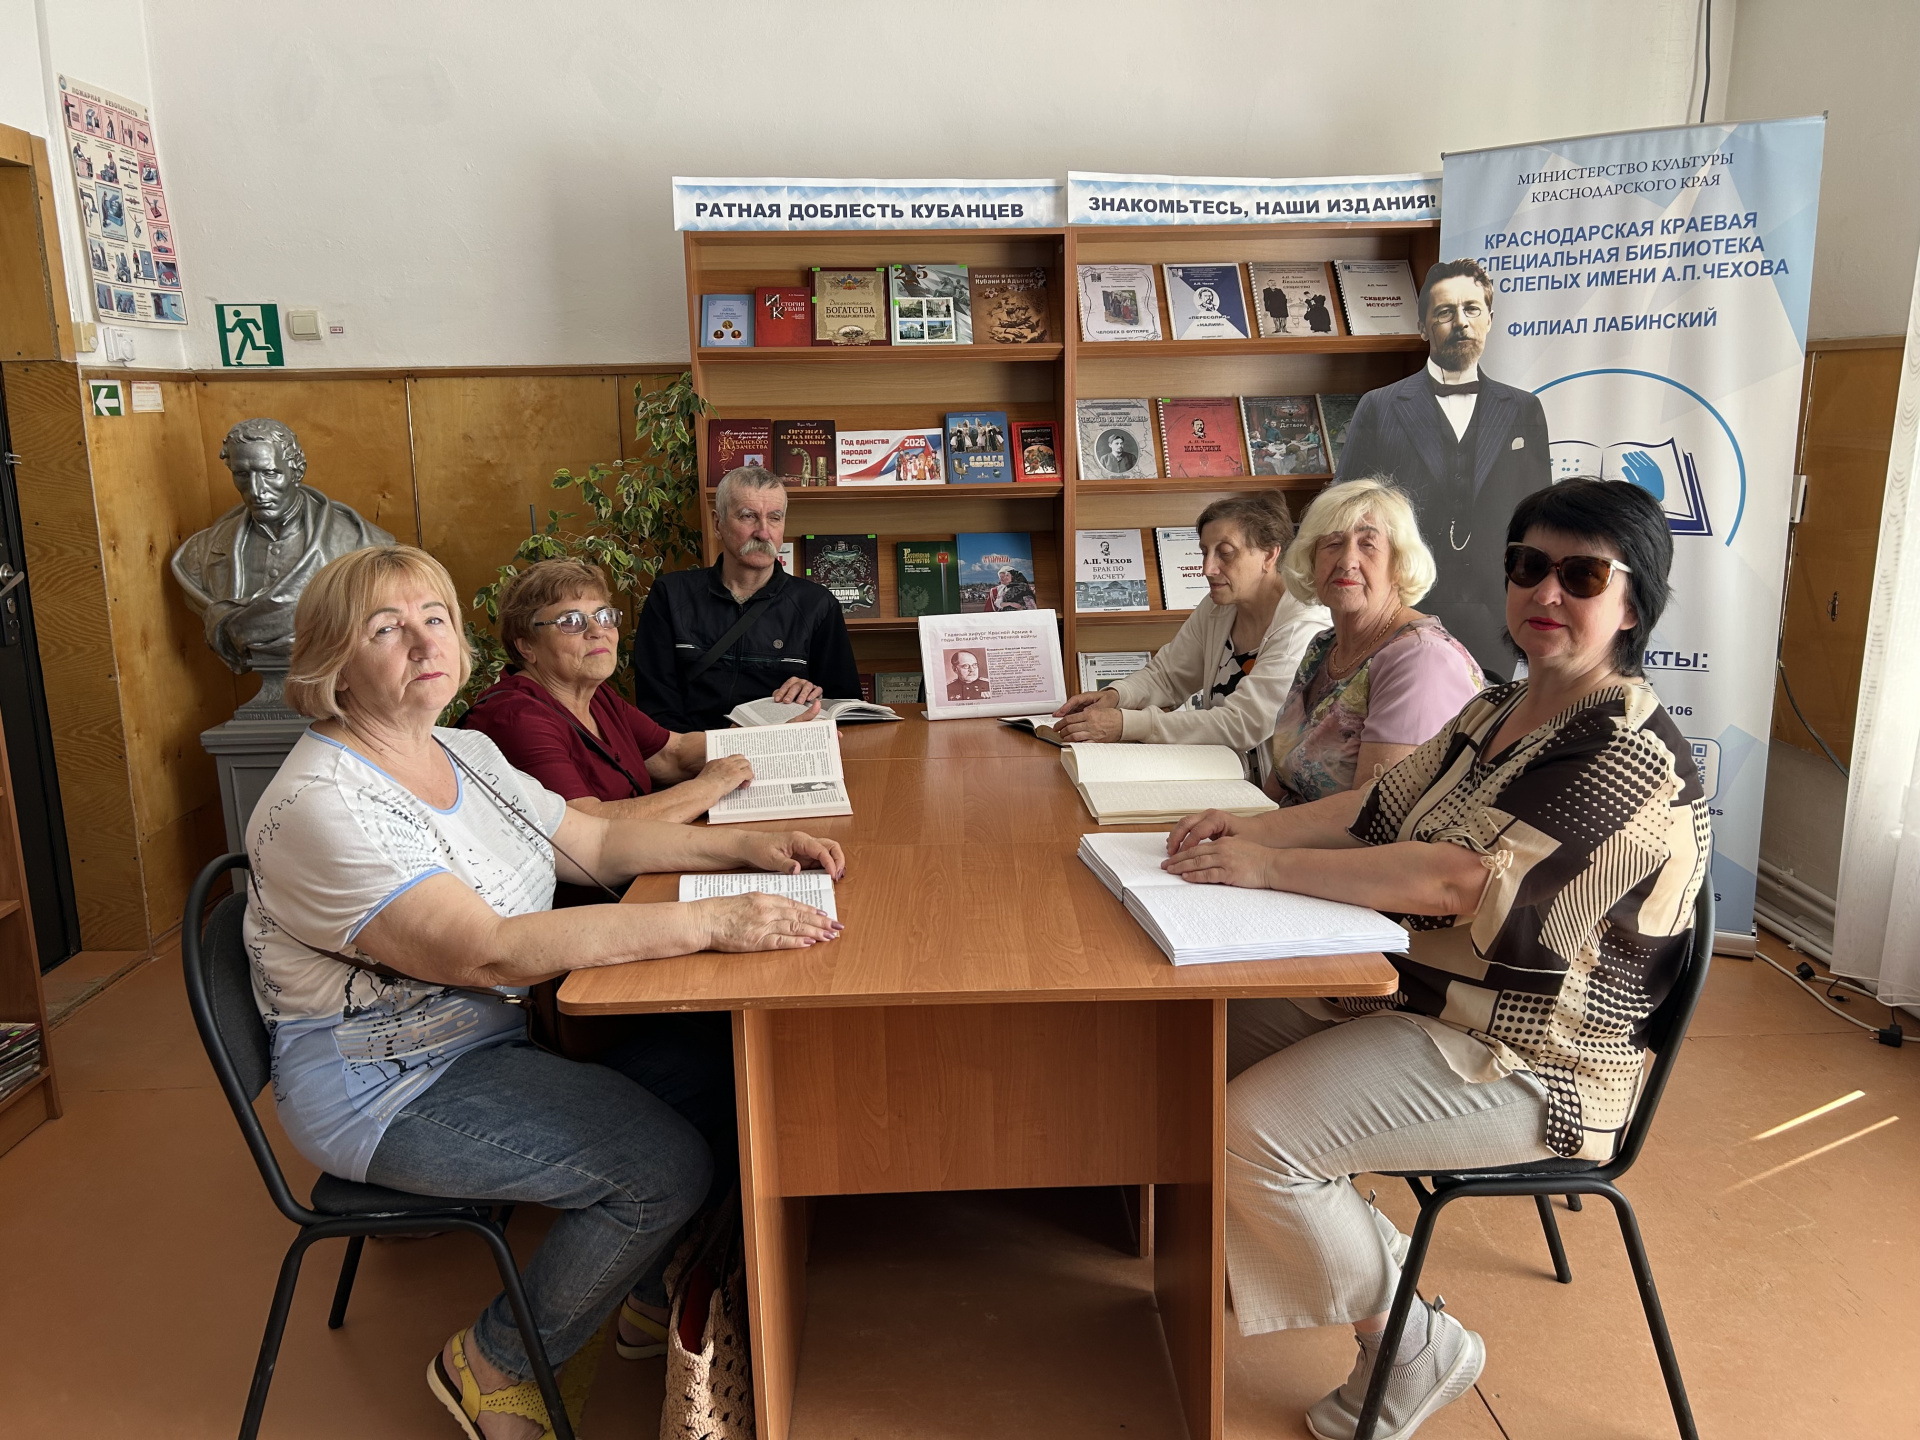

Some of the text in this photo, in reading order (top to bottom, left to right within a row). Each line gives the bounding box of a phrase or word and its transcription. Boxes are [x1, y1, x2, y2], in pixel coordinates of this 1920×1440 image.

[1517, 152, 1734, 186] МИНИСТЕРСТВО КУЛЬТУРЫ
[1531, 173, 1721, 203] КРАСНОДАРСКОГО КРАЯ
[695, 202, 1024, 221] РАТНАЯ ДОБЛЕСТЬ КУБАНЦЕВ
[1089, 195, 1436, 218] ЗНАКОМЬТЕСЬ, НАШИ ИЗДАНИЯ!
[1484, 212, 1758, 250] КРАСНОДАРСКАЯ КРАЕВАЯ
[1477, 236, 1765, 274] СПЕЦИАЛЬНАЯ БИБЛИОТЕКА
[1500, 273, 1580, 293] СЛЕПЫХ
[1586, 267, 1656, 288] ИМЕНИ
[1507, 306, 1717, 338] ФИЛИАЛ ЛАБИНСКИЙ
[904, 438, 926, 446] 2026
[1644, 650, 1708, 669] КТЫ:
